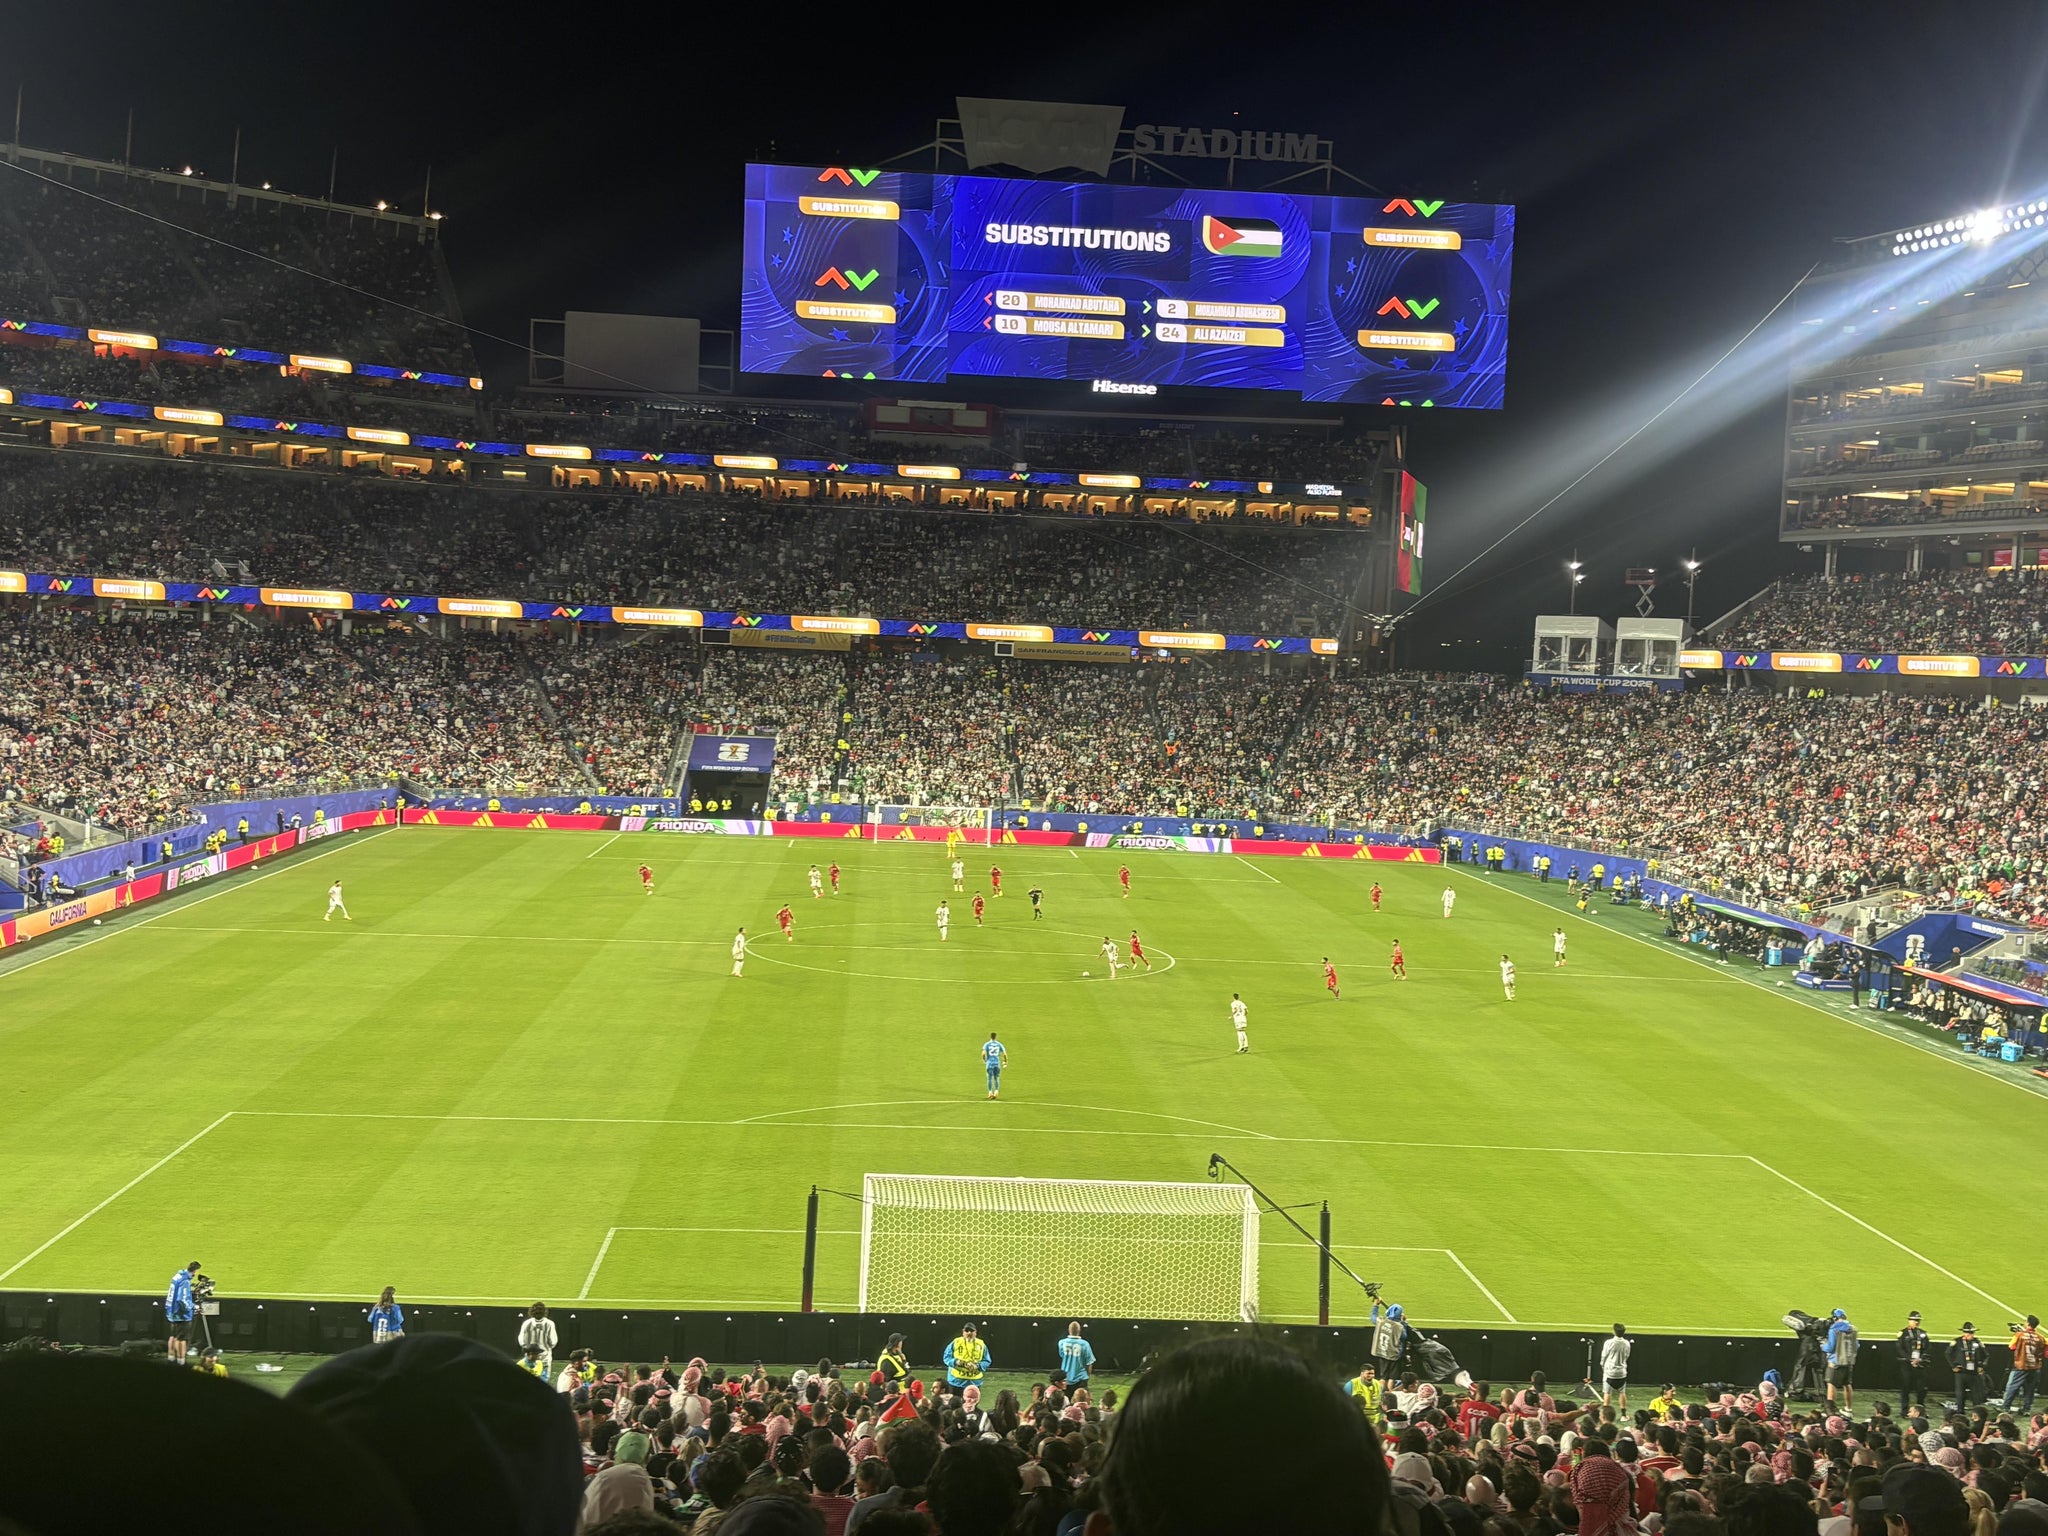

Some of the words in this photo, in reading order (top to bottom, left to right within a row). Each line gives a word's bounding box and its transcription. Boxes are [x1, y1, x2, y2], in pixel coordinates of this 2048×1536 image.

[1133, 124, 1319, 163] STADIUM
[811, 201, 887, 215] SUBSTITUTION
[985, 223, 1171, 253] SUBSTITUTIONS
[1375, 232, 1449, 245] SUBSTITUTION
[1002, 294, 1020, 306] 20
[808, 305, 883, 319] SUBSTITUTION
[1167, 303, 1177, 314] 2
[1001, 318, 1019, 330] 10
[1033, 319, 1067, 333] MOUSA
[1067, 321, 1114, 336] ALTAMARI
[1161, 327, 1180, 339] 24
[1370, 334, 1443, 347] SUBSTITUTION
[1092, 379, 1157, 395] Hisense
[1036, 647, 1085, 656] FRANCISCO
[1570, 677, 1602, 686] WORLD
[1604, 678, 1621, 687] CUP
[1622, 679, 1654, 688] 2026
[651, 821, 715, 831] TRIONDA
[1116, 837, 1177, 848] TRIONDA
[49, 901, 88, 927] CALIFORNIA
